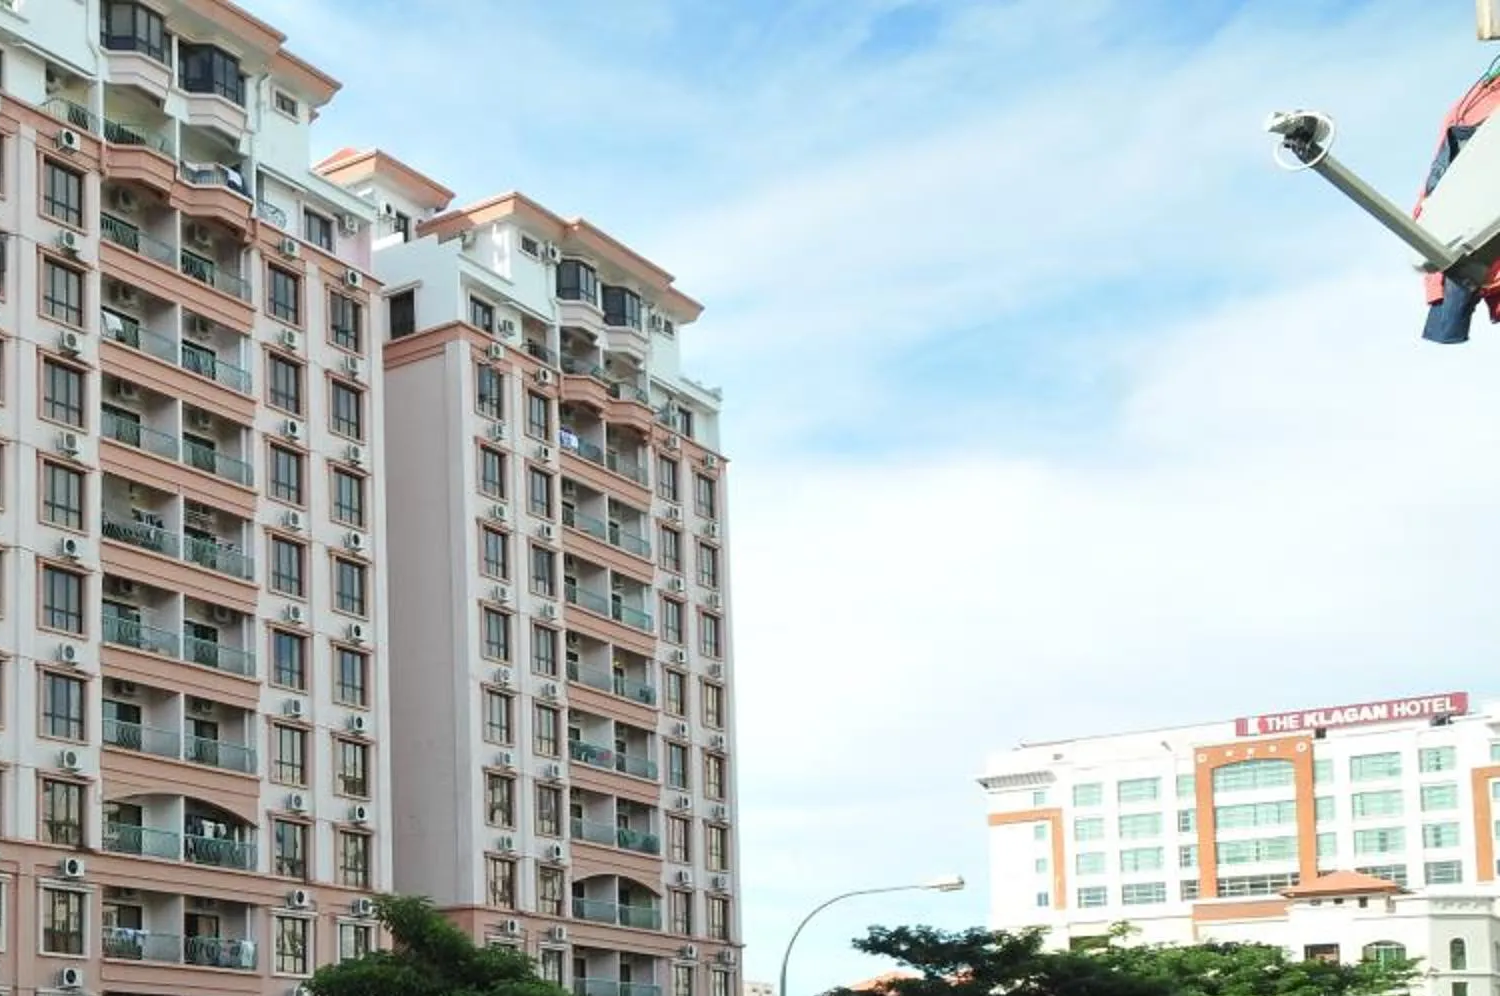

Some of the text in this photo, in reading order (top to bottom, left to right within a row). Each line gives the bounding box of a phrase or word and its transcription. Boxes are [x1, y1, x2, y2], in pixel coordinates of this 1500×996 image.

[1266, 697, 1457, 731] THE KLAGAN HOTEL
